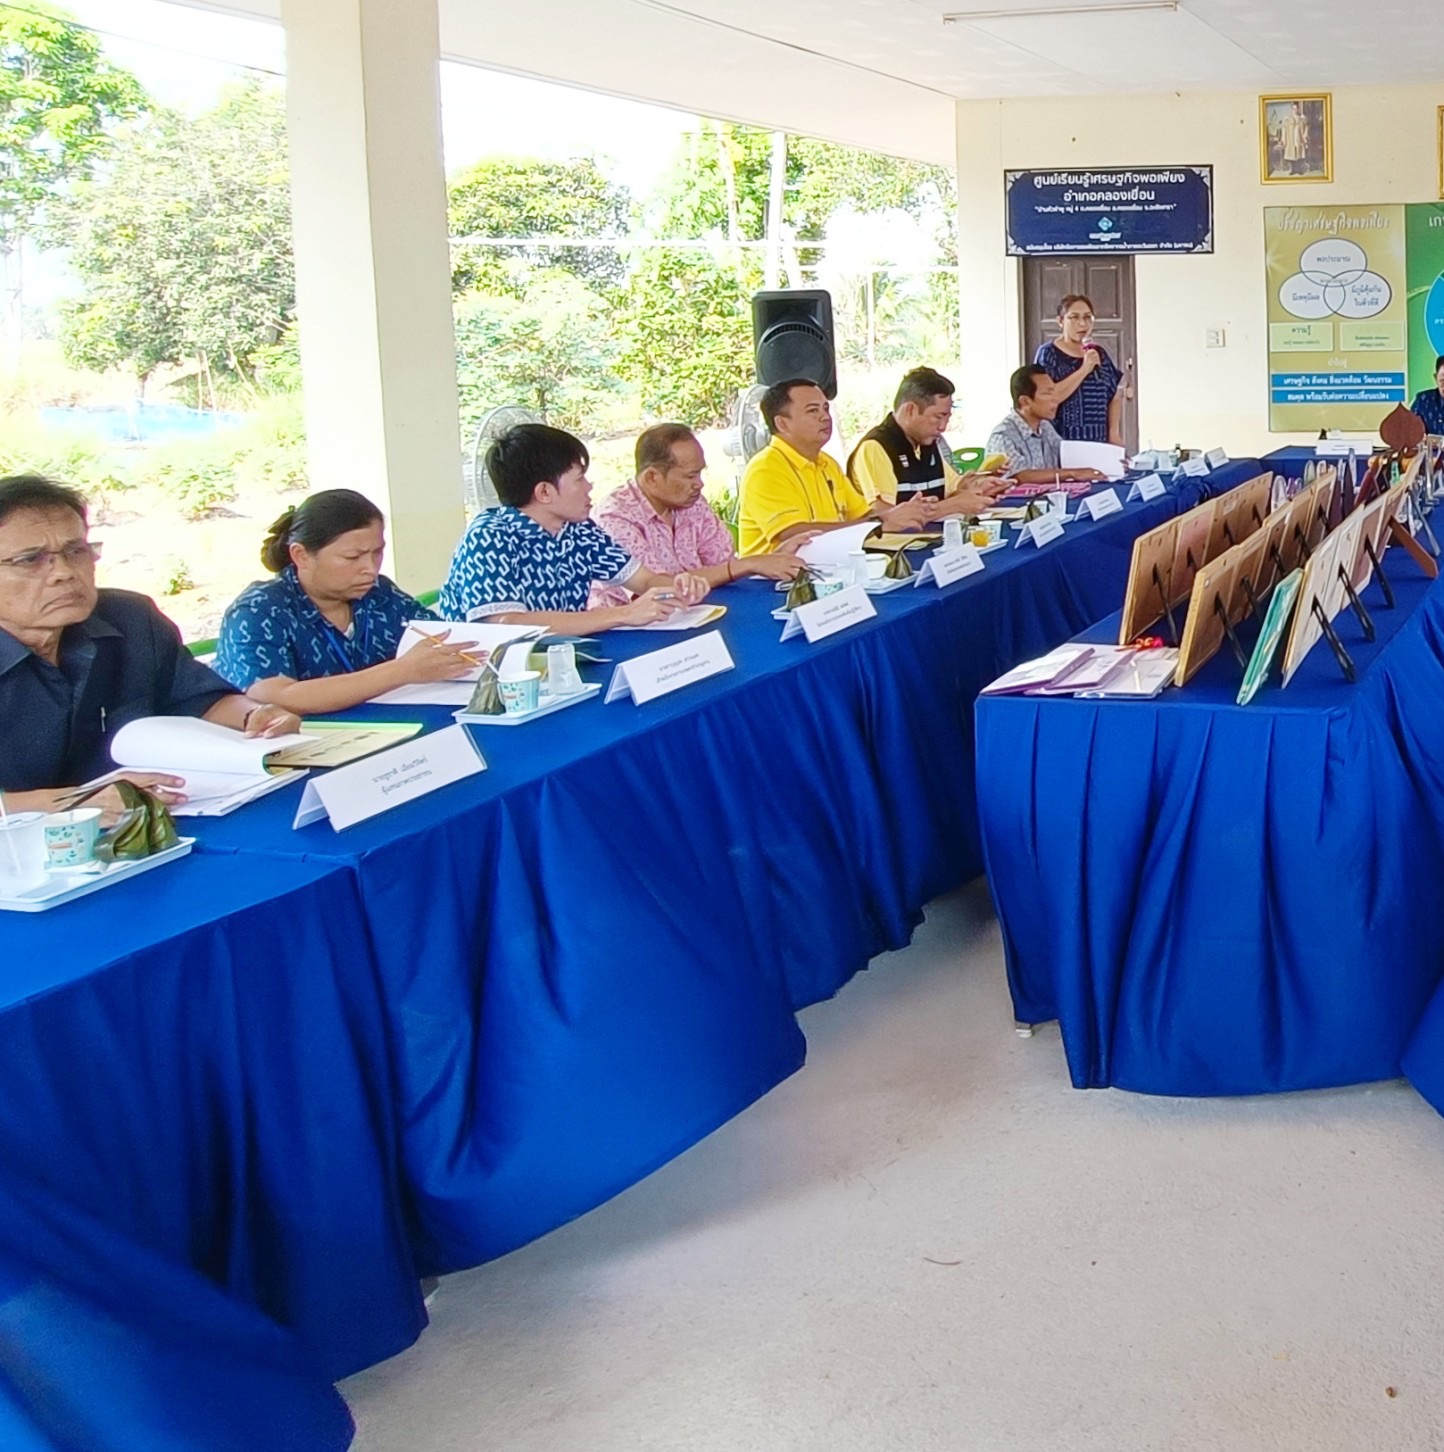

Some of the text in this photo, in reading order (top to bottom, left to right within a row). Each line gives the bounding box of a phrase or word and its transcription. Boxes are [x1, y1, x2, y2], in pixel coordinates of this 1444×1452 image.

[1034, 172, 1185, 189] ศูนย์เรียนรู้เศรษฐกิจพอเพียง
[1063, 186, 1155, 202] อำเภอคลองเขื่อน
[1292, 325, 1311, 335] ความรู้
[1283, 376, 1310, 386] เศรษฐกิจ
